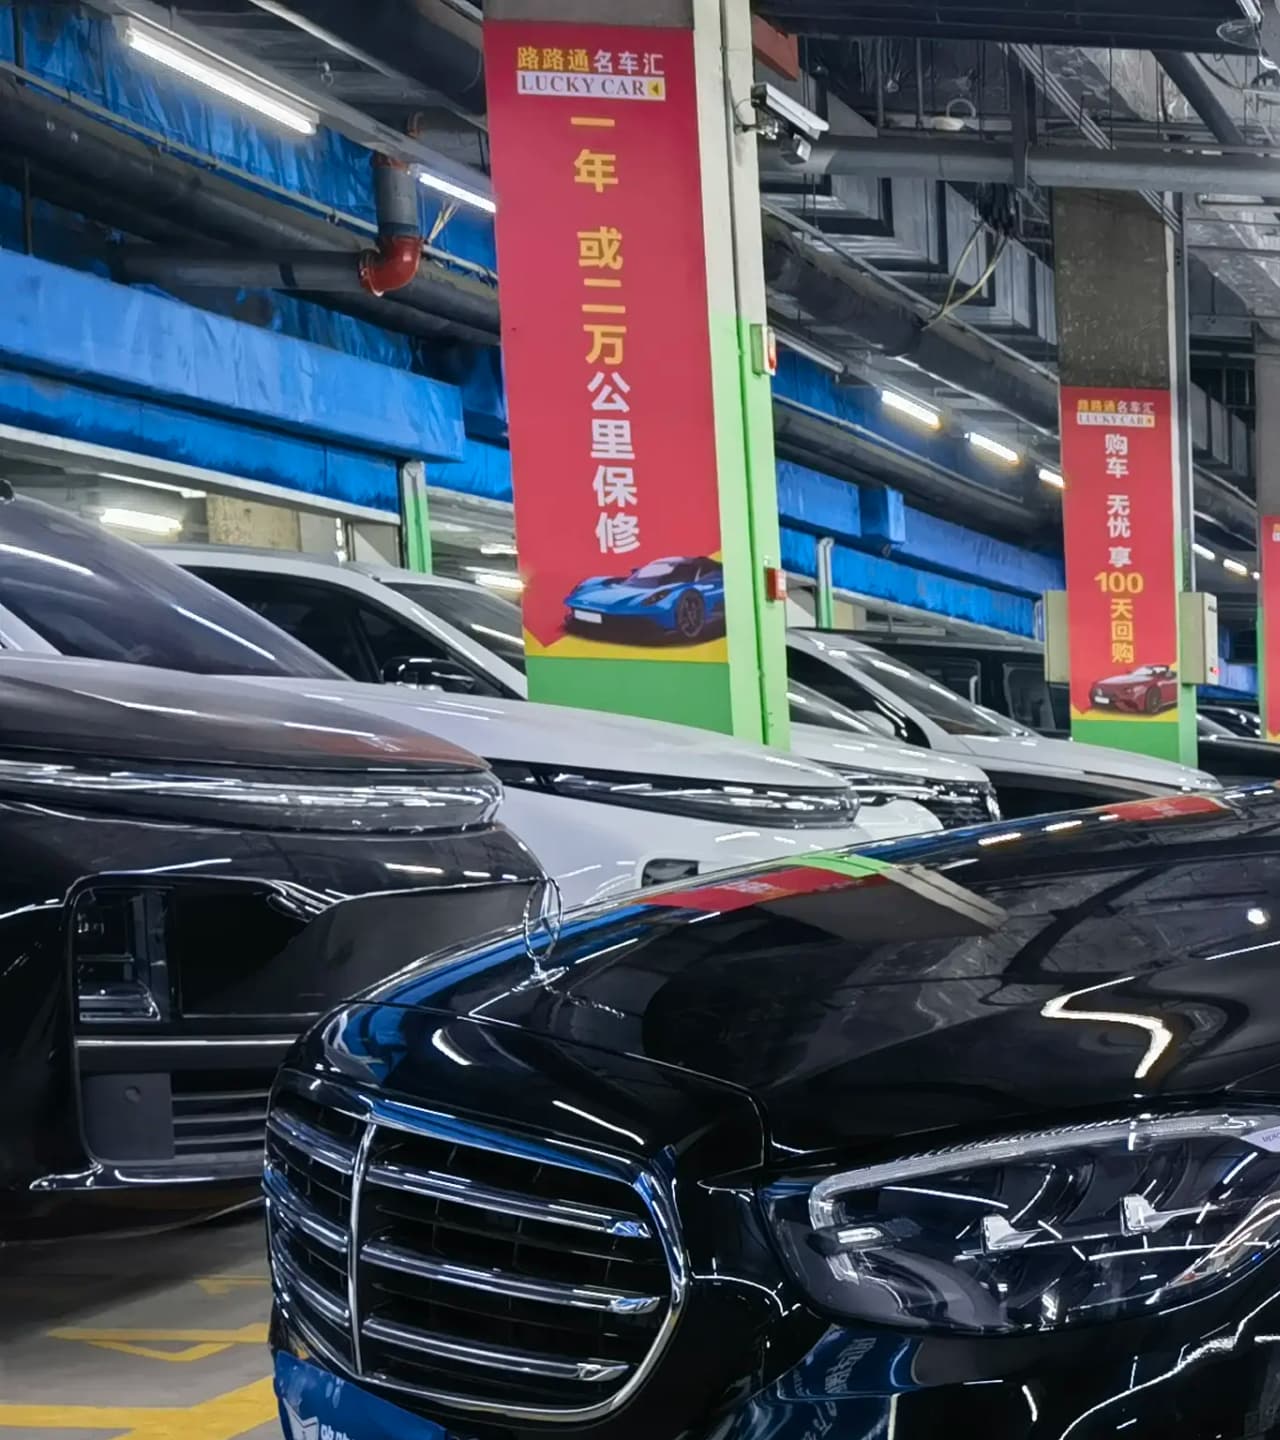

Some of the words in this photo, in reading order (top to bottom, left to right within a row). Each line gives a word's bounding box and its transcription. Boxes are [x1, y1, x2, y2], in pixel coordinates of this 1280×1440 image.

[517, 46, 664, 75] 路路通名车汇
[520, 74, 594, 93] LUCKY
[601, 79, 645, 96] CAR
